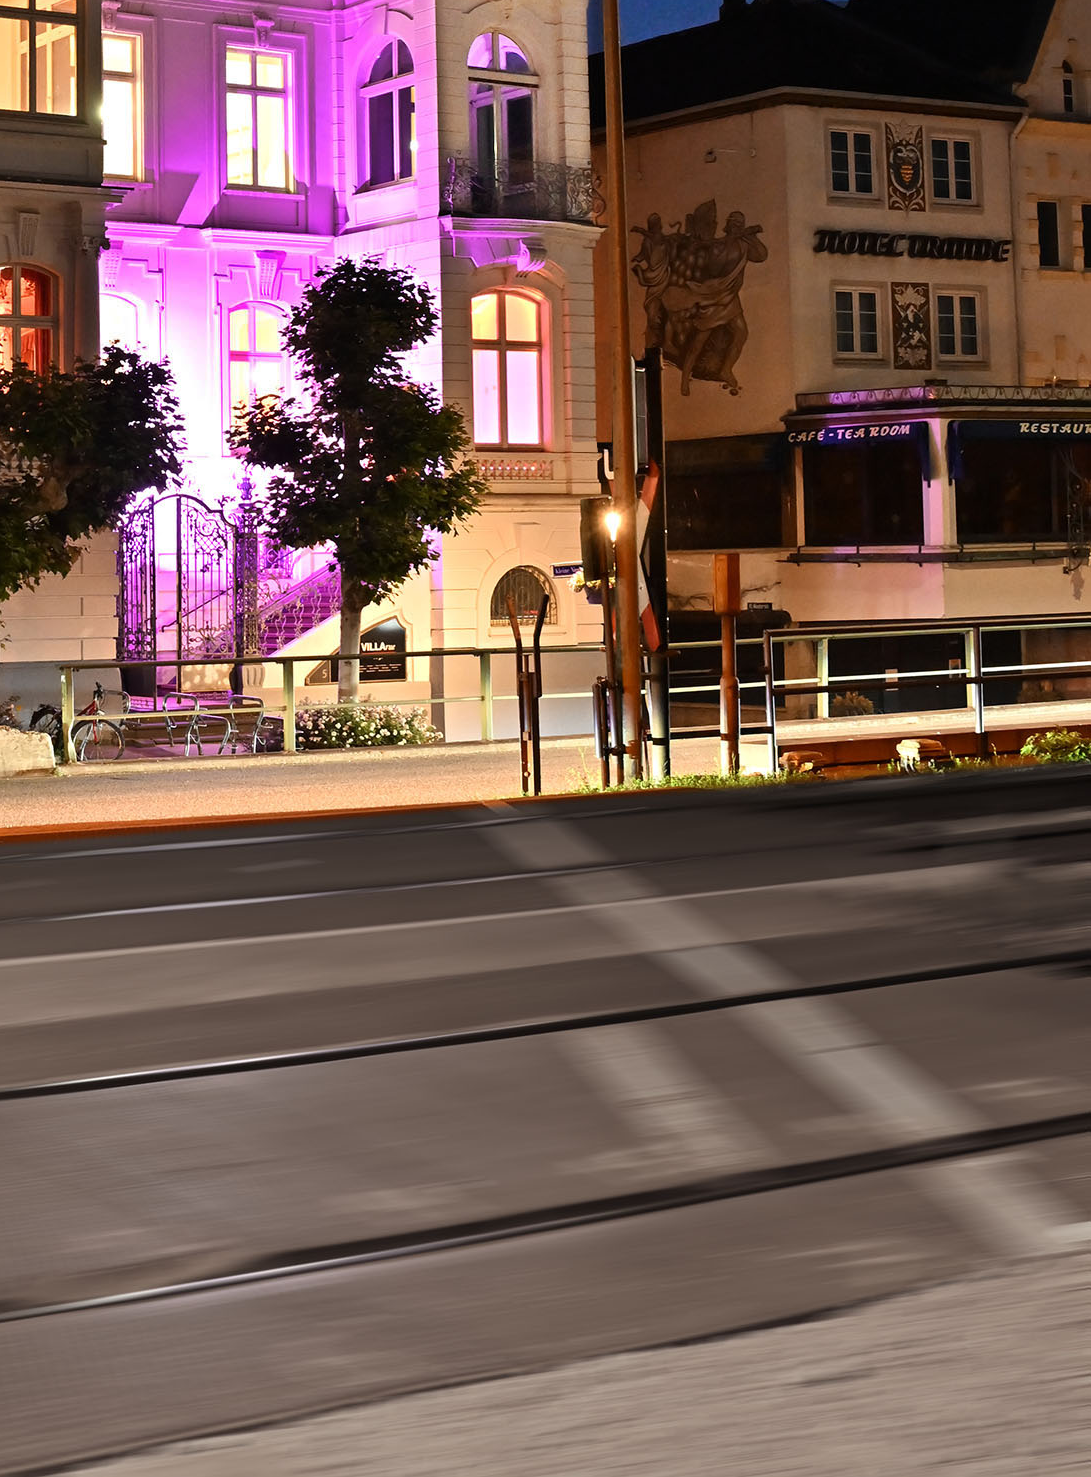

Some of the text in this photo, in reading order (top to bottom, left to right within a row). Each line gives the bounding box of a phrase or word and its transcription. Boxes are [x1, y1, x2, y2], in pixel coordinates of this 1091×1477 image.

[813, 229, 907, 257] HOTEL
[787, 428, 825, 443] CAFÉ
[836, 427, 865, 440] TEA
[868, 424, 910, 437] ROOM
